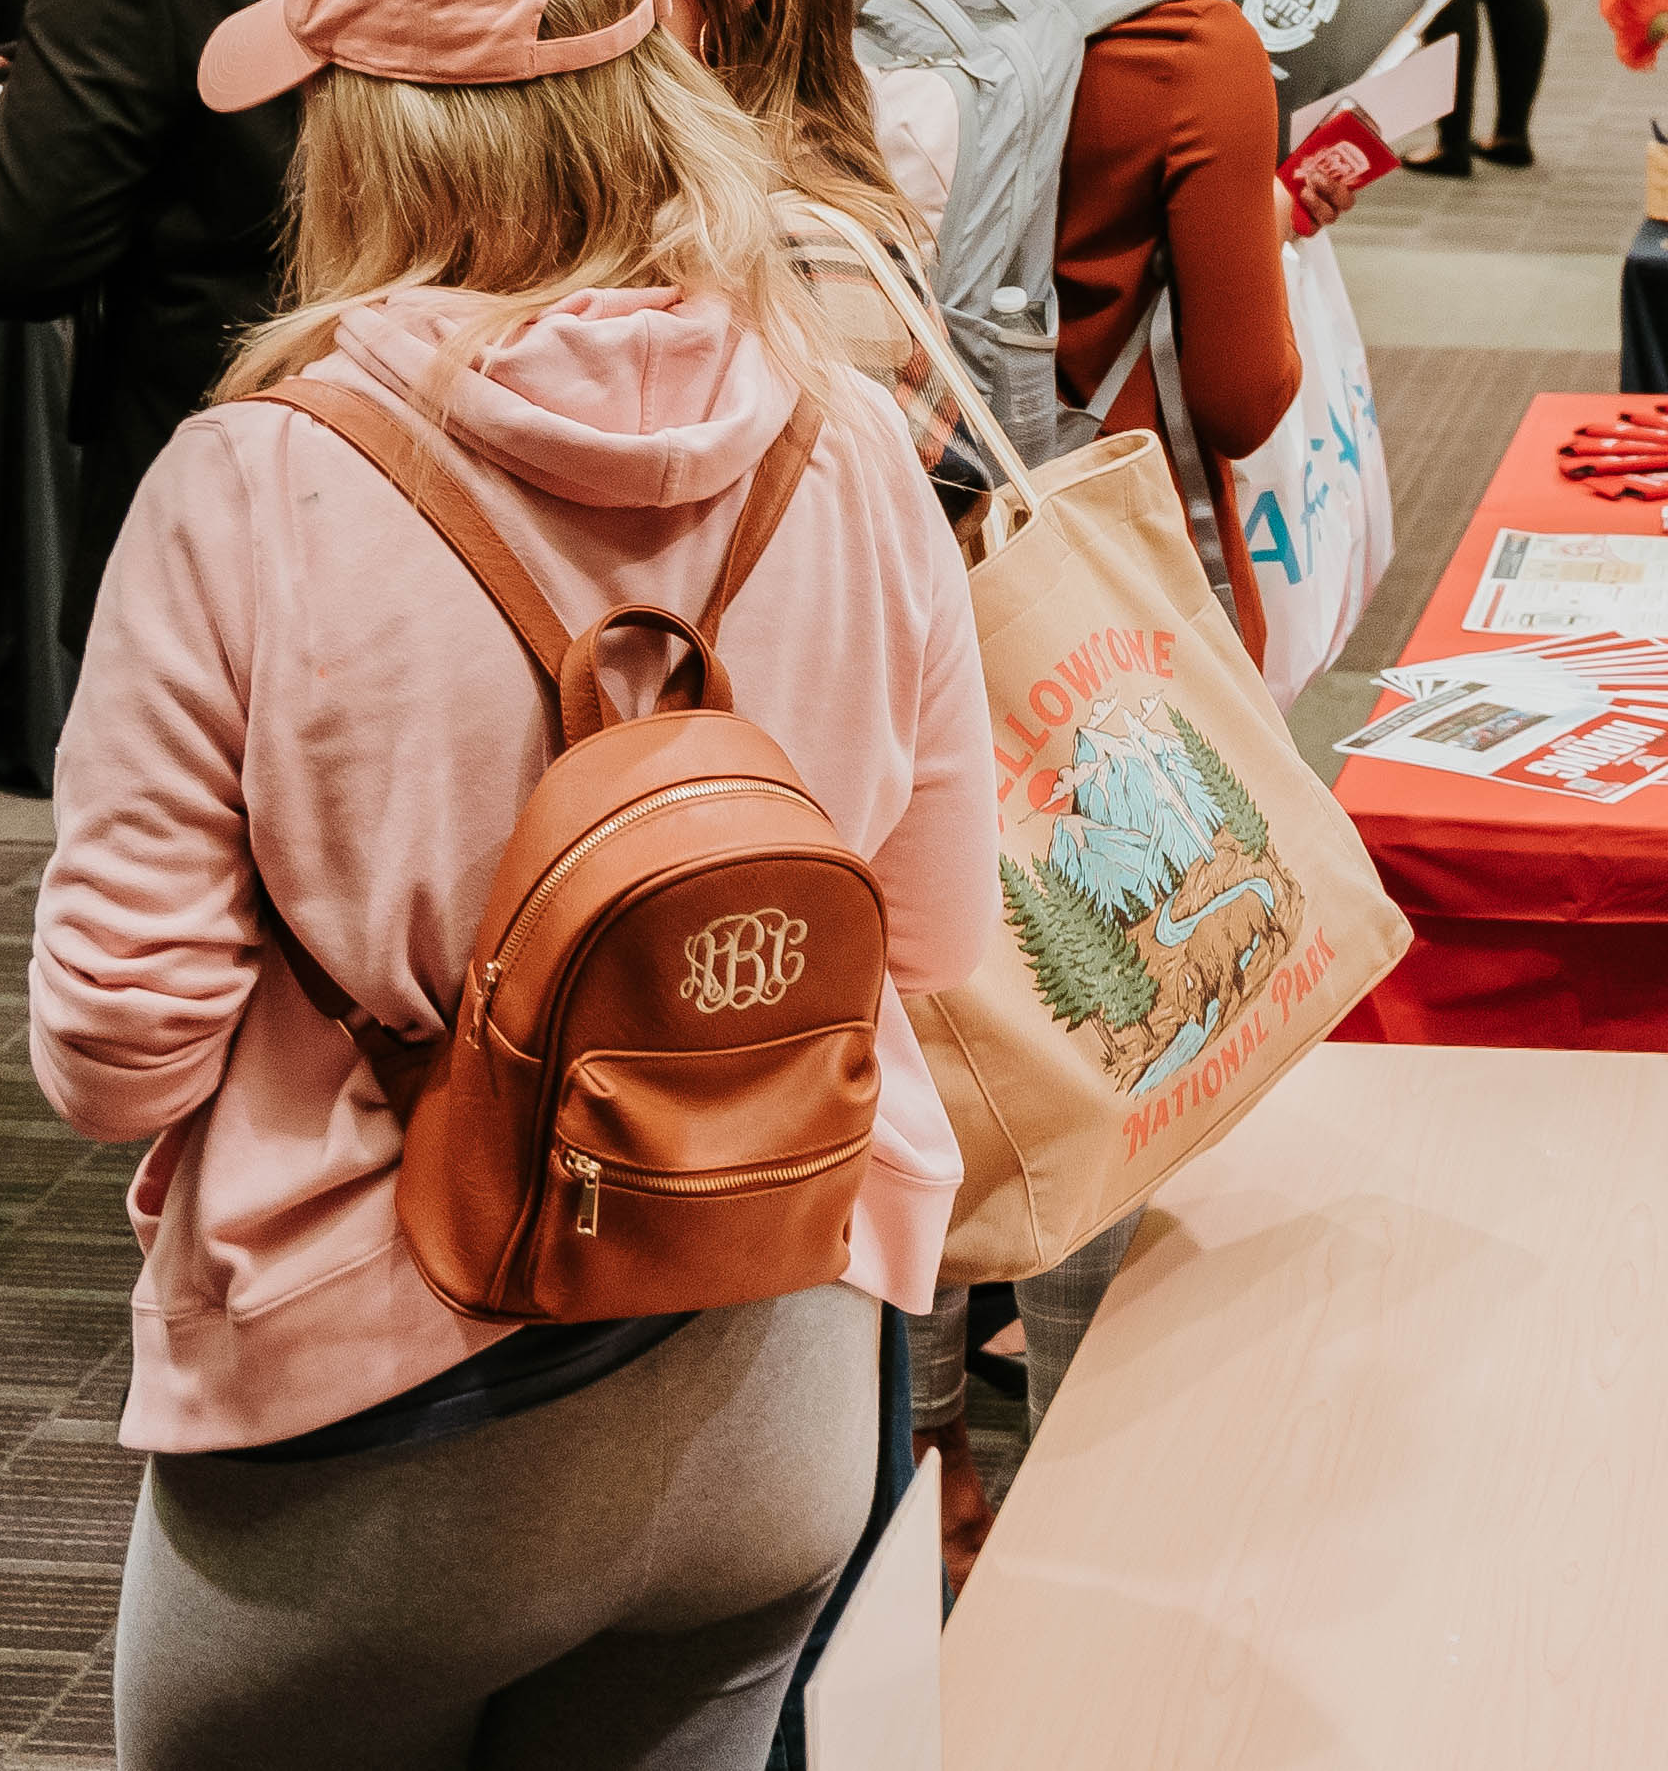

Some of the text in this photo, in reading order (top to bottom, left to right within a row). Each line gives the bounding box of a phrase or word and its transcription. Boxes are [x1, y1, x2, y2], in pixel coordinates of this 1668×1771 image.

[1524, 719, 1667, 780] HIRING
[1123, 926, 1336, 1166] NATIONAL PARK
